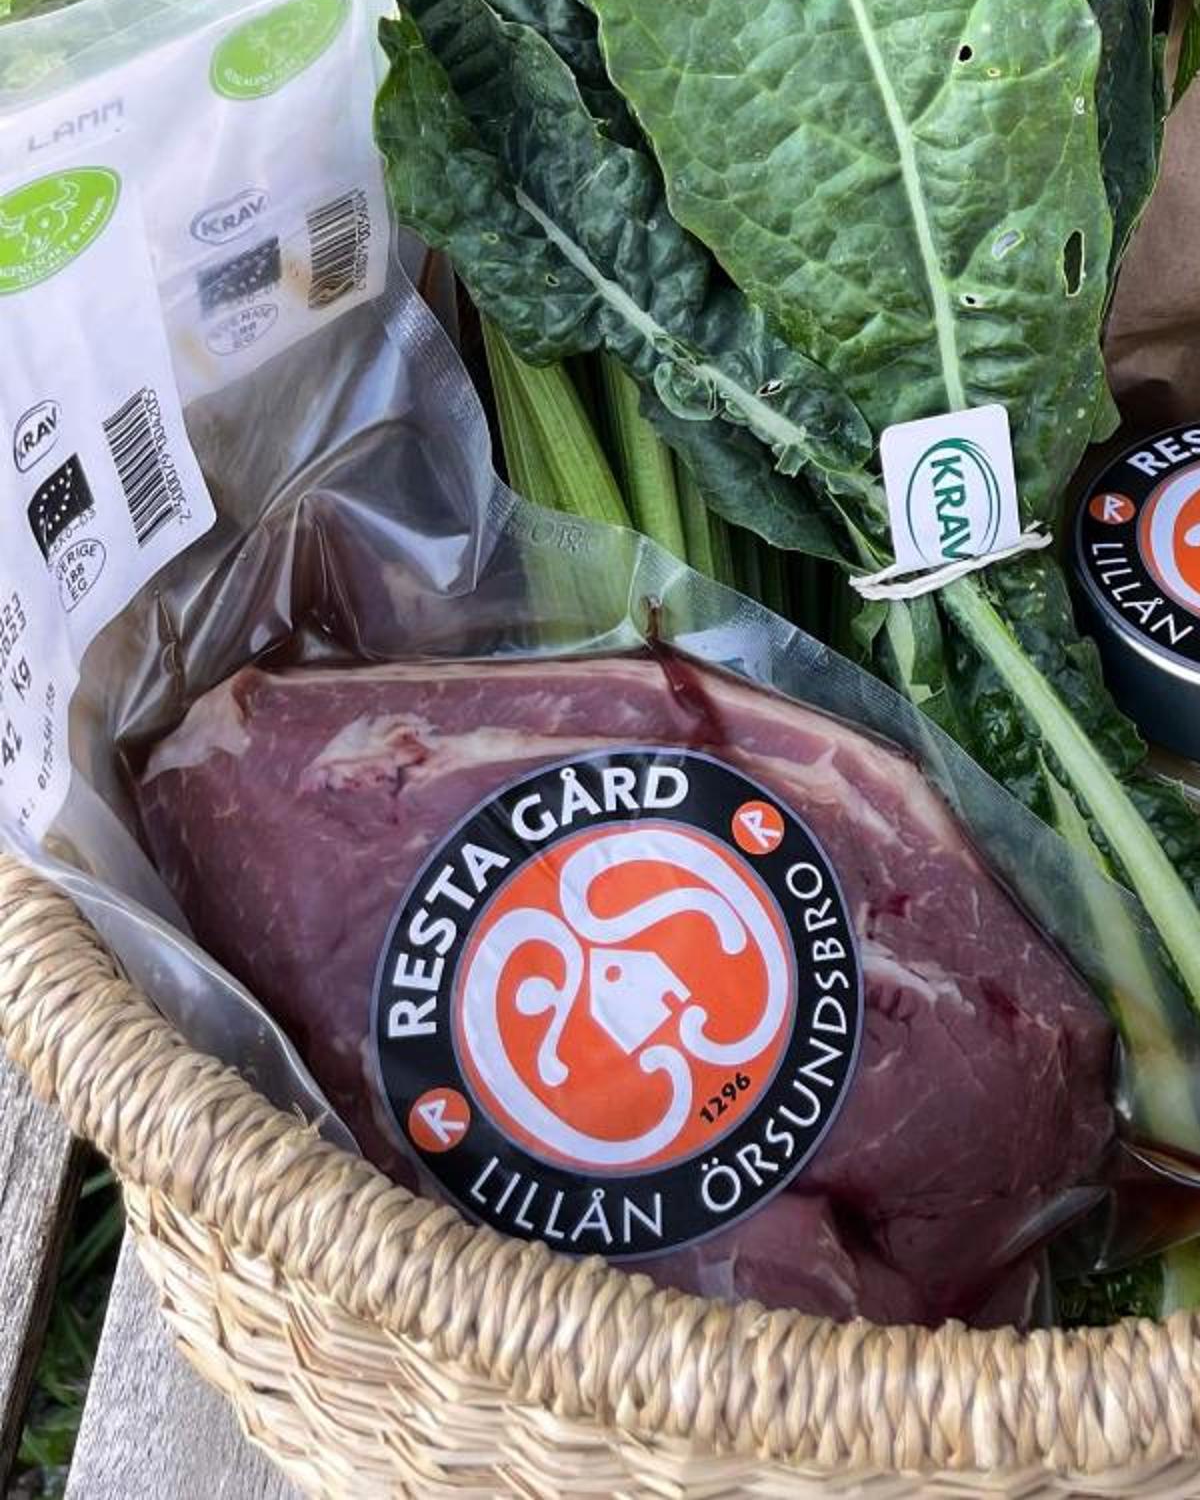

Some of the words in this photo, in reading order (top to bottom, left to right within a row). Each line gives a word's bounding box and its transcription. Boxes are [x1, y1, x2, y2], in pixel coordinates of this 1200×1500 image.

[27, 96, 124, 152] LAMM
[201, 195, 265, 236] KRAV
[930, 455, 975, 560] KRAV
[70, 577, 88, 602] EG
[1091, 542, 1195, 646] LILLÅN
[387, 840, 511, 1039] RESTA
[509, 766, 690, 842] GÅRD
[470, 1156, 664, 1245] LILLÅN
[701, 861, 850, 1212] ÖRSUNDSBRO
[699, 1072, 752, 1124] 1296
